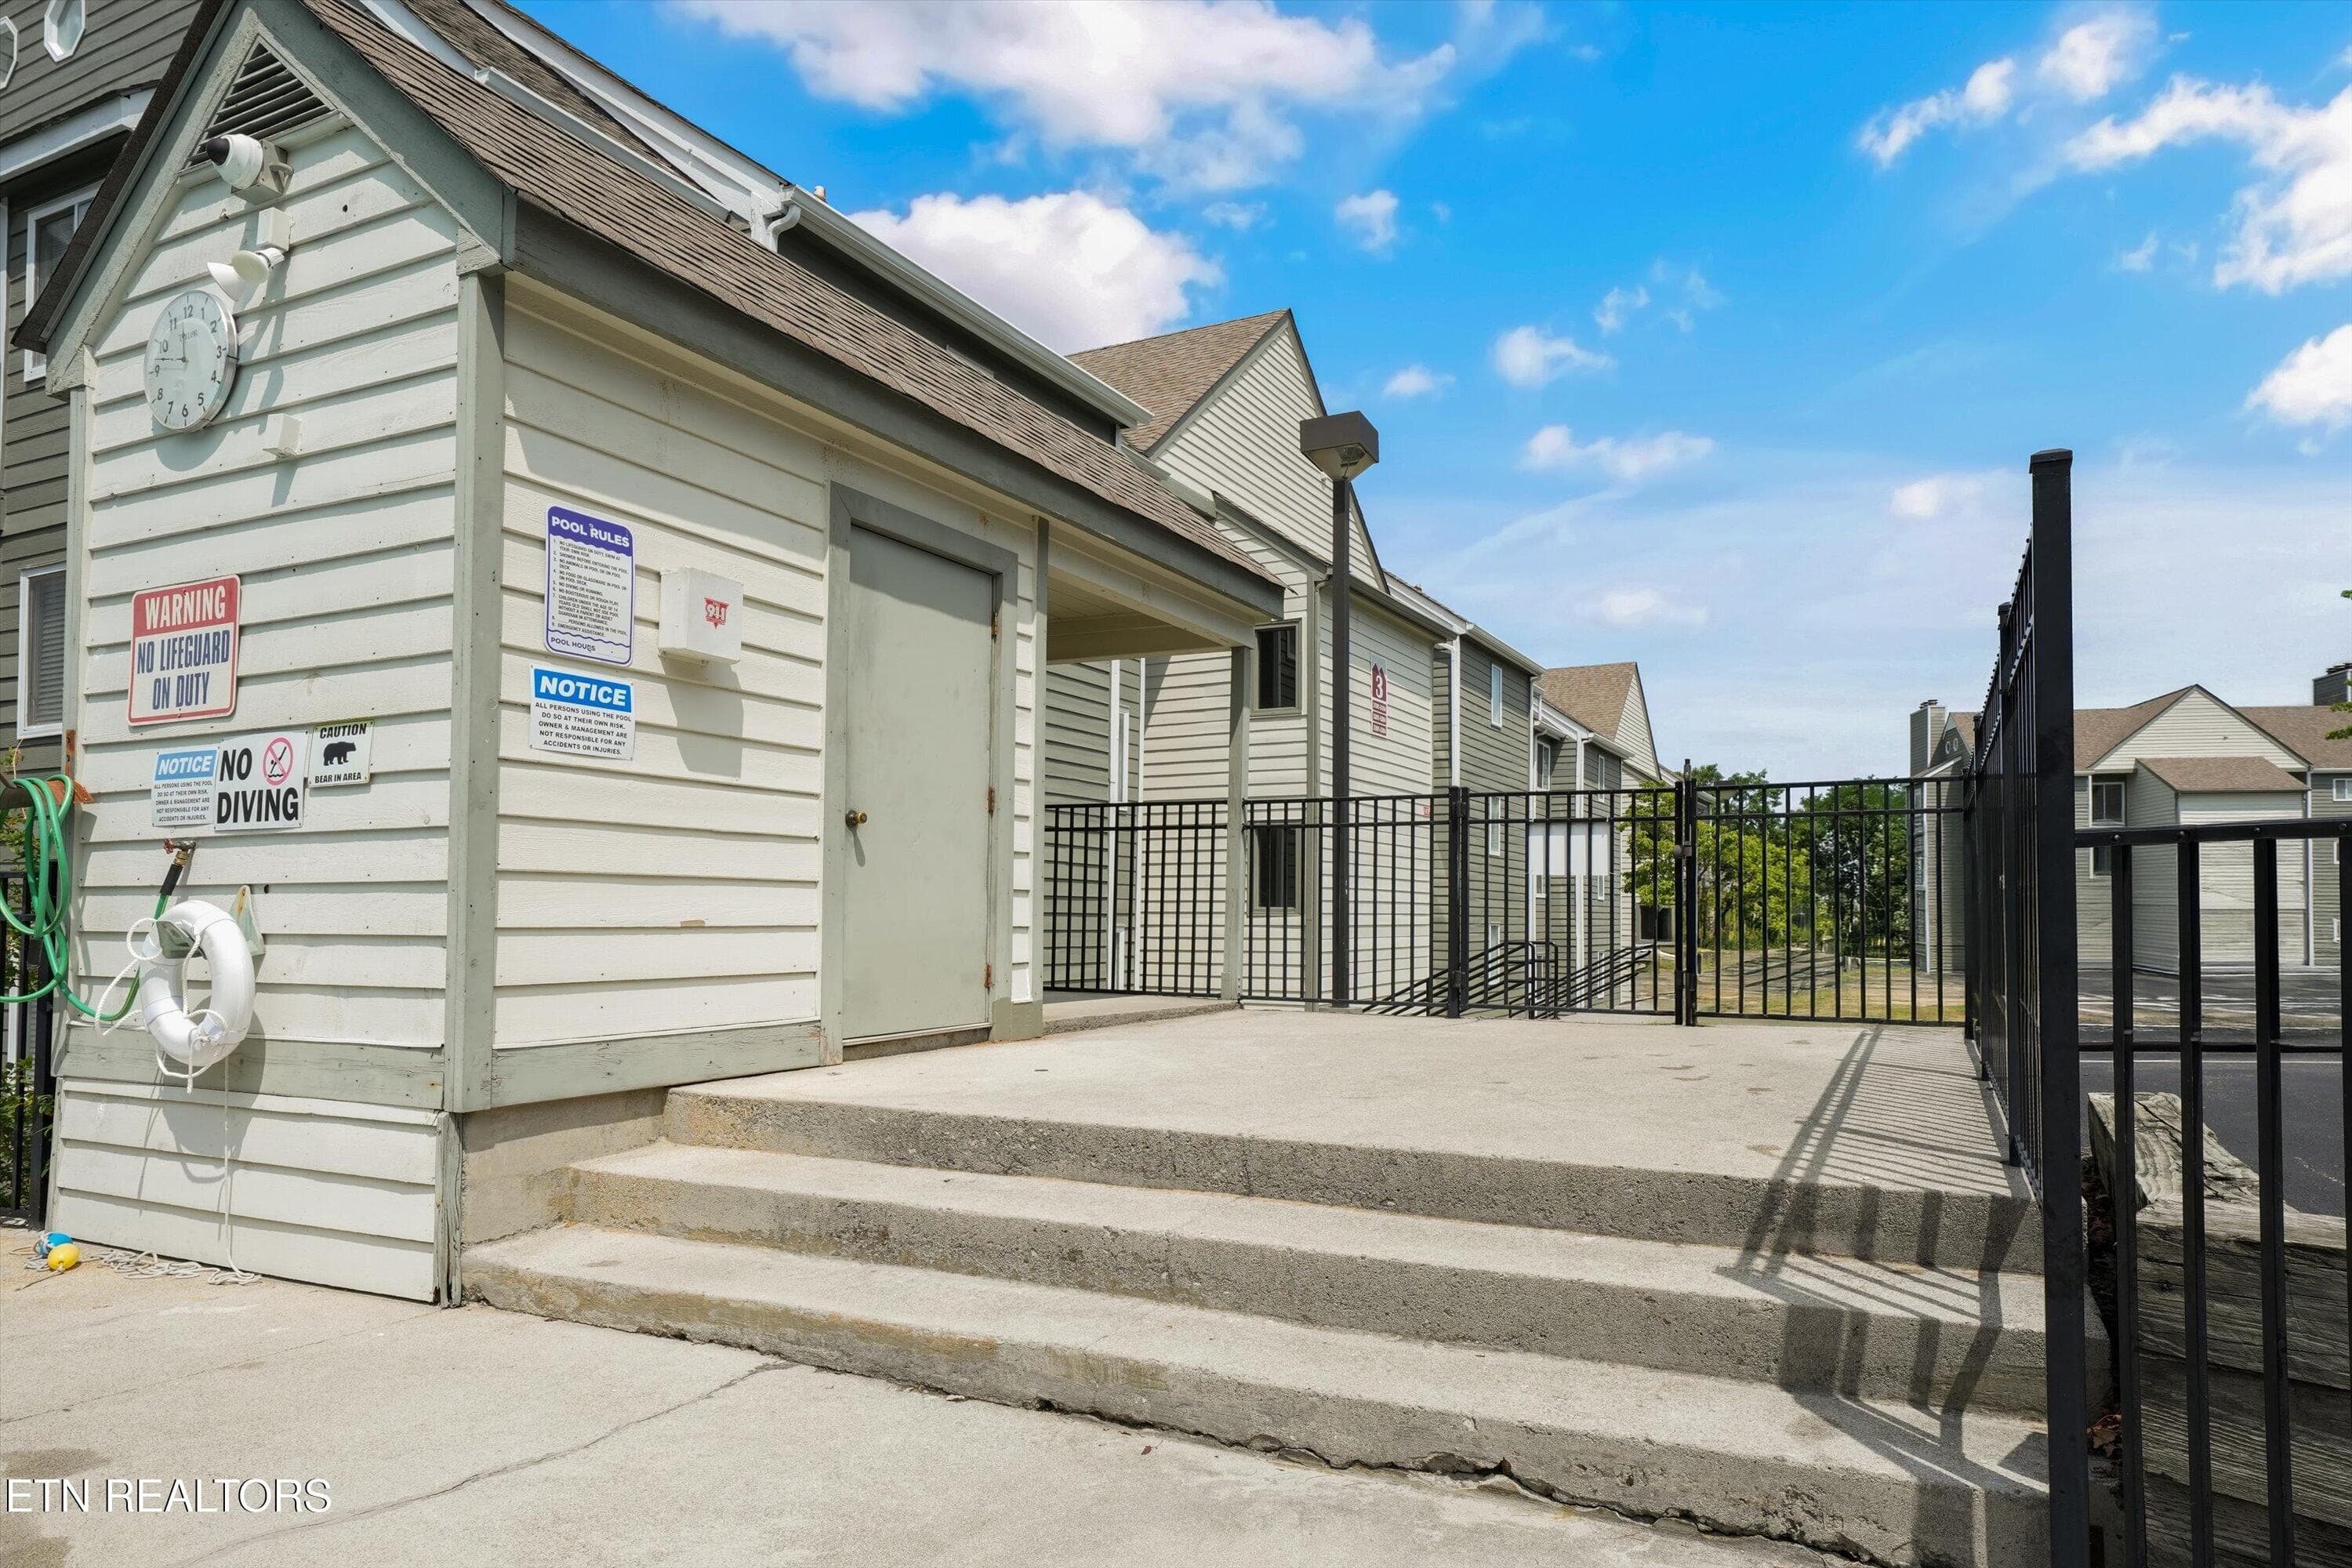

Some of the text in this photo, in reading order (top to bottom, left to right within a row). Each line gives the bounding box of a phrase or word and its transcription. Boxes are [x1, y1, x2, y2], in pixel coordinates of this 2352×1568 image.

[183, 305, 193, 318] 12
[170, 318, 177, 330] 11
[211, 321, 217, 333] 2
[160, 339, 168, 354] 10
[216, 346, 222, 358] 3
[155, 365, 160, 377] 9
[211, 370, 216, 383] 4
[158, 388, 162, 400] 8
[198, 393, 204, 406] 5
[169, 401, 174, 414] 7
[182, 404, 188, 417] 6
[552, 516, 629, 547] POOL RULES
[145, 586, 226, 630] WARNING
[706, 604, 725, 621] 911
[551, 637, 595, 652] POOL HOURS
[137, 630, 230, 674] NO LIFEGUARD
[153, 672, 209, 710] ON DUTY
[540, 676, 626, 706] NOTICE
[1376, 675, 1383, 698] 3
[550, 705, 579, 713] PERSONS
[320, 724, 366, 739] CAUTION
[555, 732, 598, 743] RESPONSIBLE
[572, 726, 614, 736] MANAGEMENT
[543, 740, 580, 750] ACCIDENTS
[593, 746, 622, 755] INJURIES.
[158, 755, 213, 775] NOTICE
[220, 748, 252, 781] NO
[315, 775, 332, 783] BEAR
[343, 772, 361, 781] AREA
[217, 788, 298, 823] DIVING
